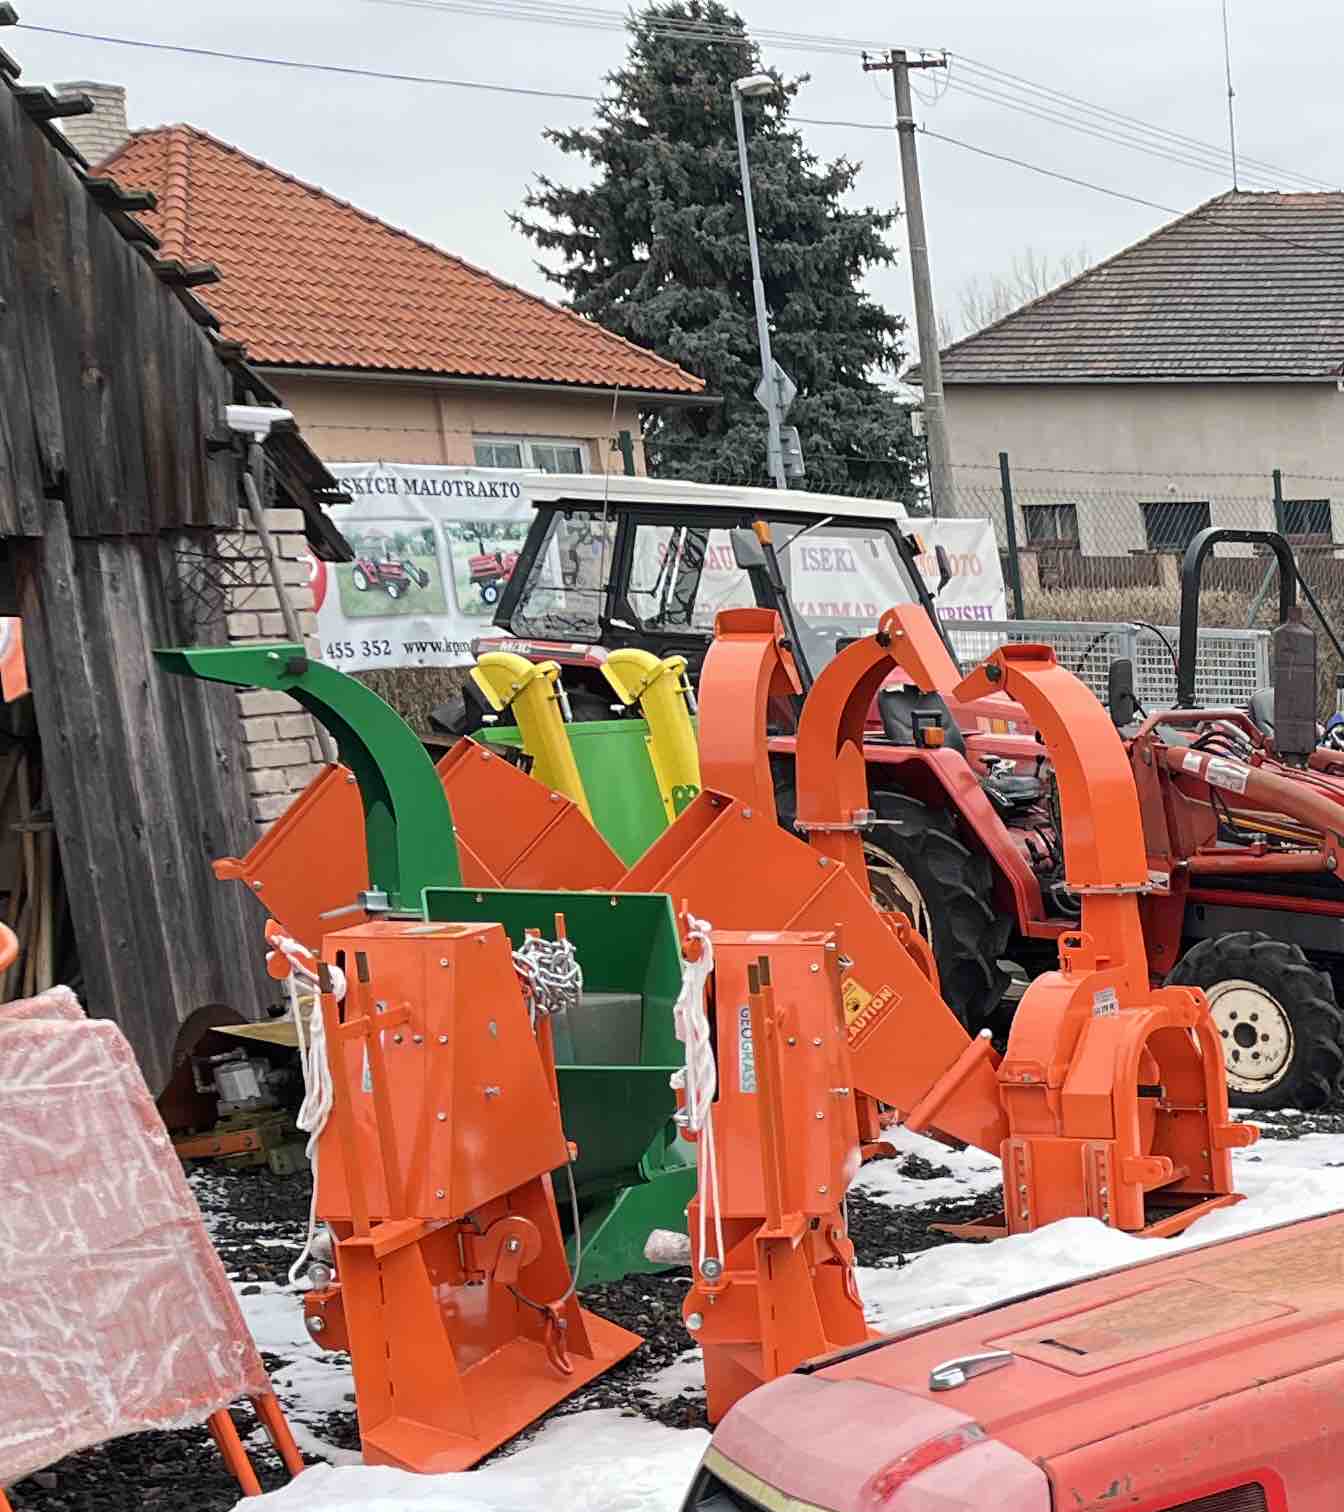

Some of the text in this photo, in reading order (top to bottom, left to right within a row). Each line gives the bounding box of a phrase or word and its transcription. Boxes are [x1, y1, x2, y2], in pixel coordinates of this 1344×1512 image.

[802, 547, 857, 572] ISEKI
[327, 637, 473, 660] 455 352 www.kpm
[849, 988, 895, 1043] AUTION
